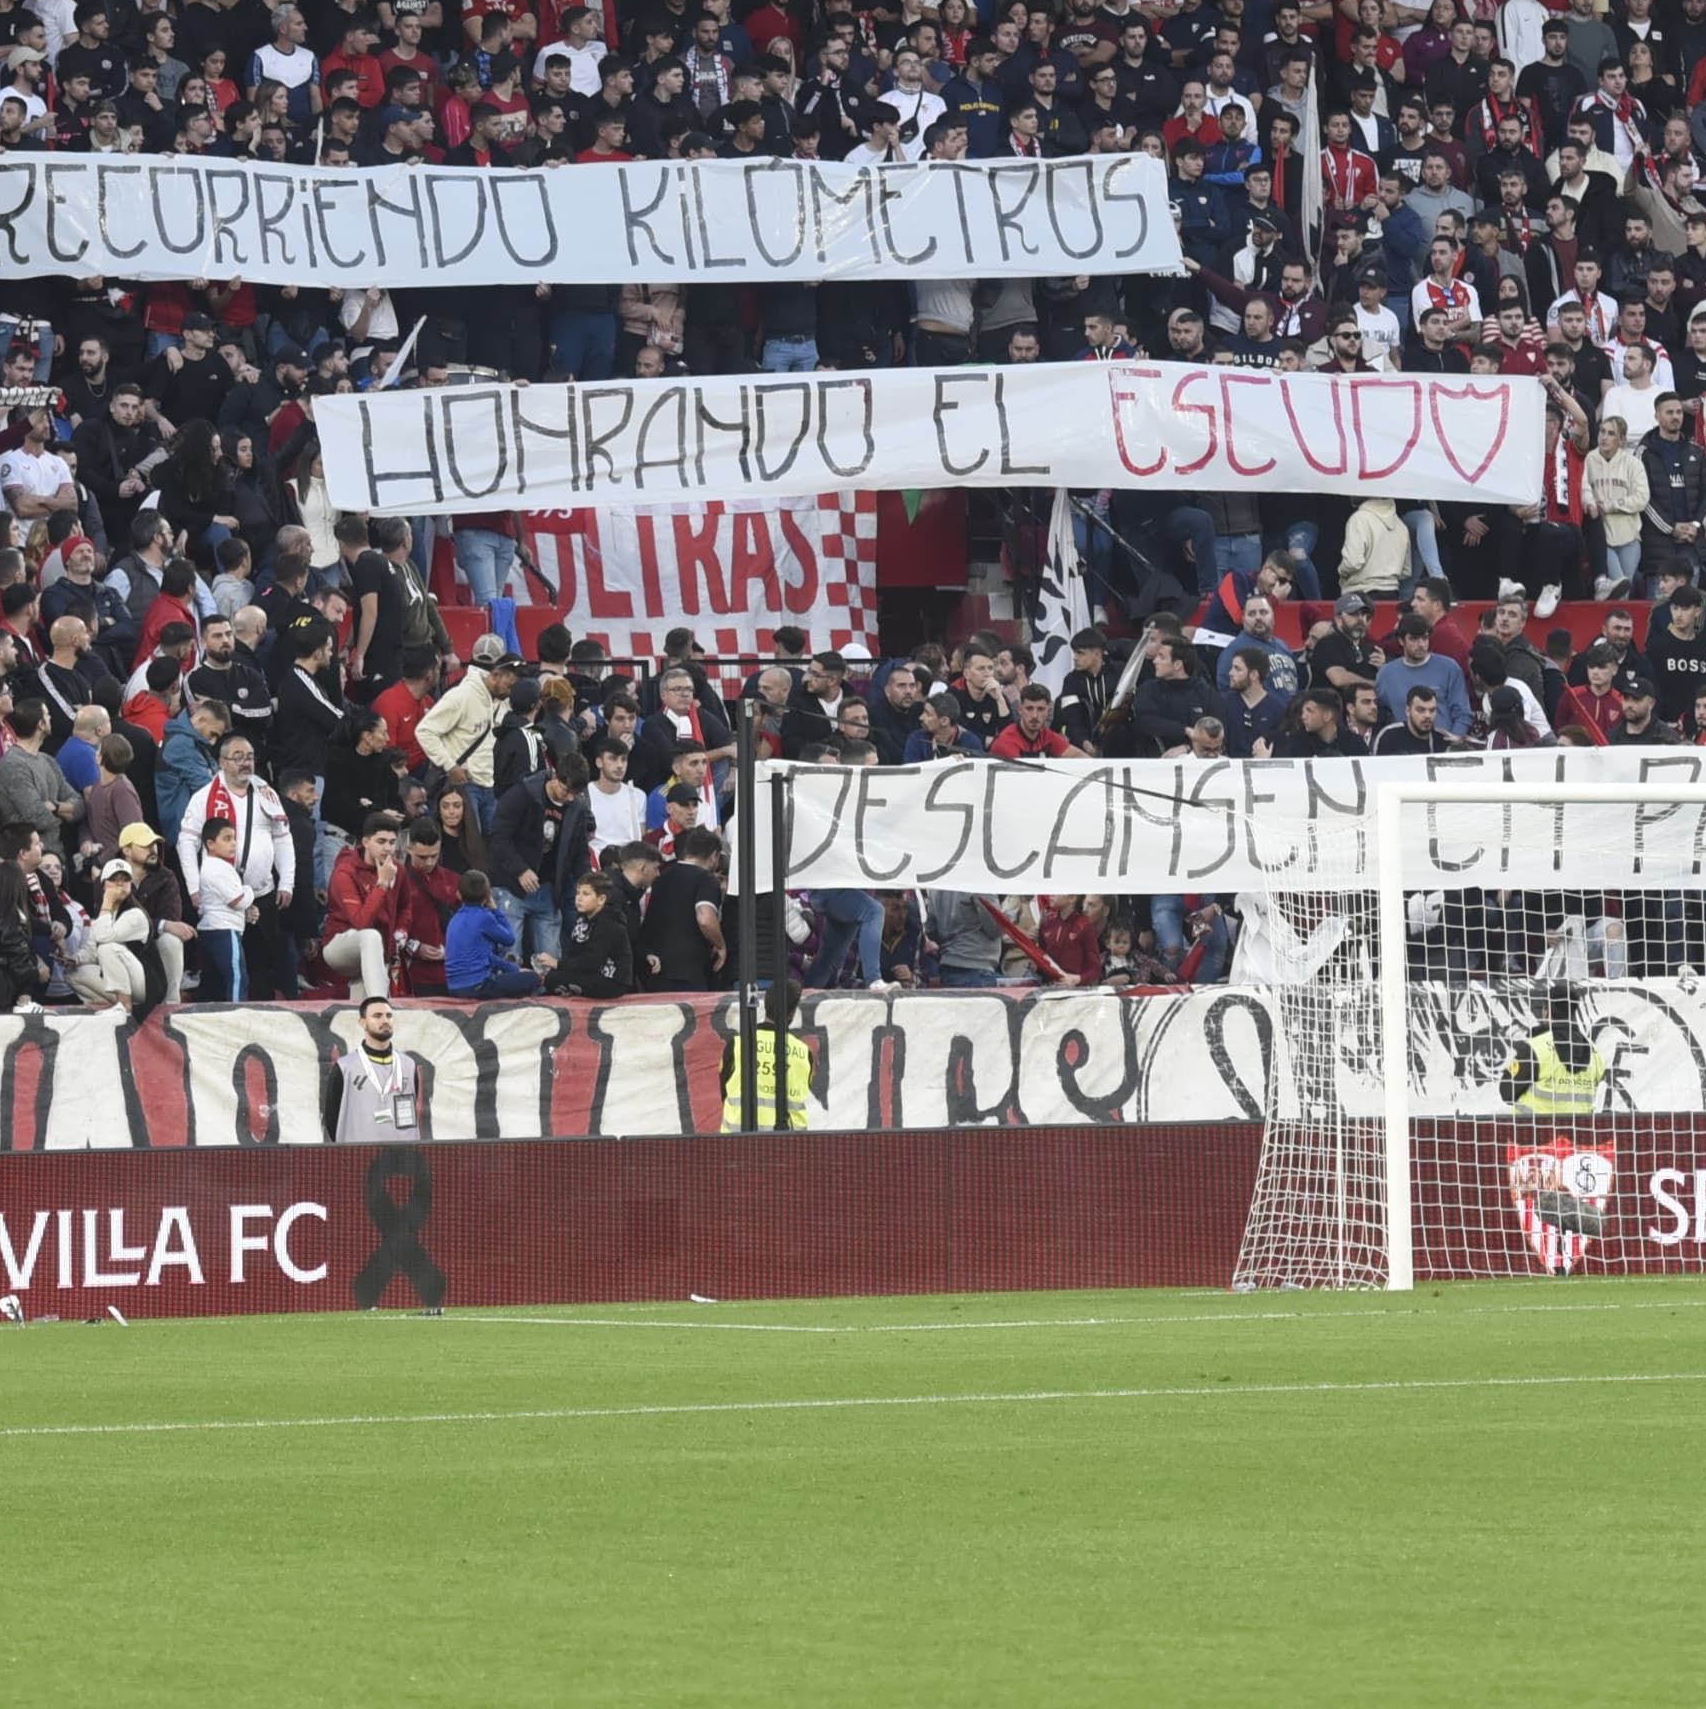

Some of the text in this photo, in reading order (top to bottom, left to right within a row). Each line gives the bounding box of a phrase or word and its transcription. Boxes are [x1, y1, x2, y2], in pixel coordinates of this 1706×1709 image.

[934, 372, 1050, 477] EL
[1427, 756, 1563, 872] EN
[231, 1199, 329, 1285] FC
